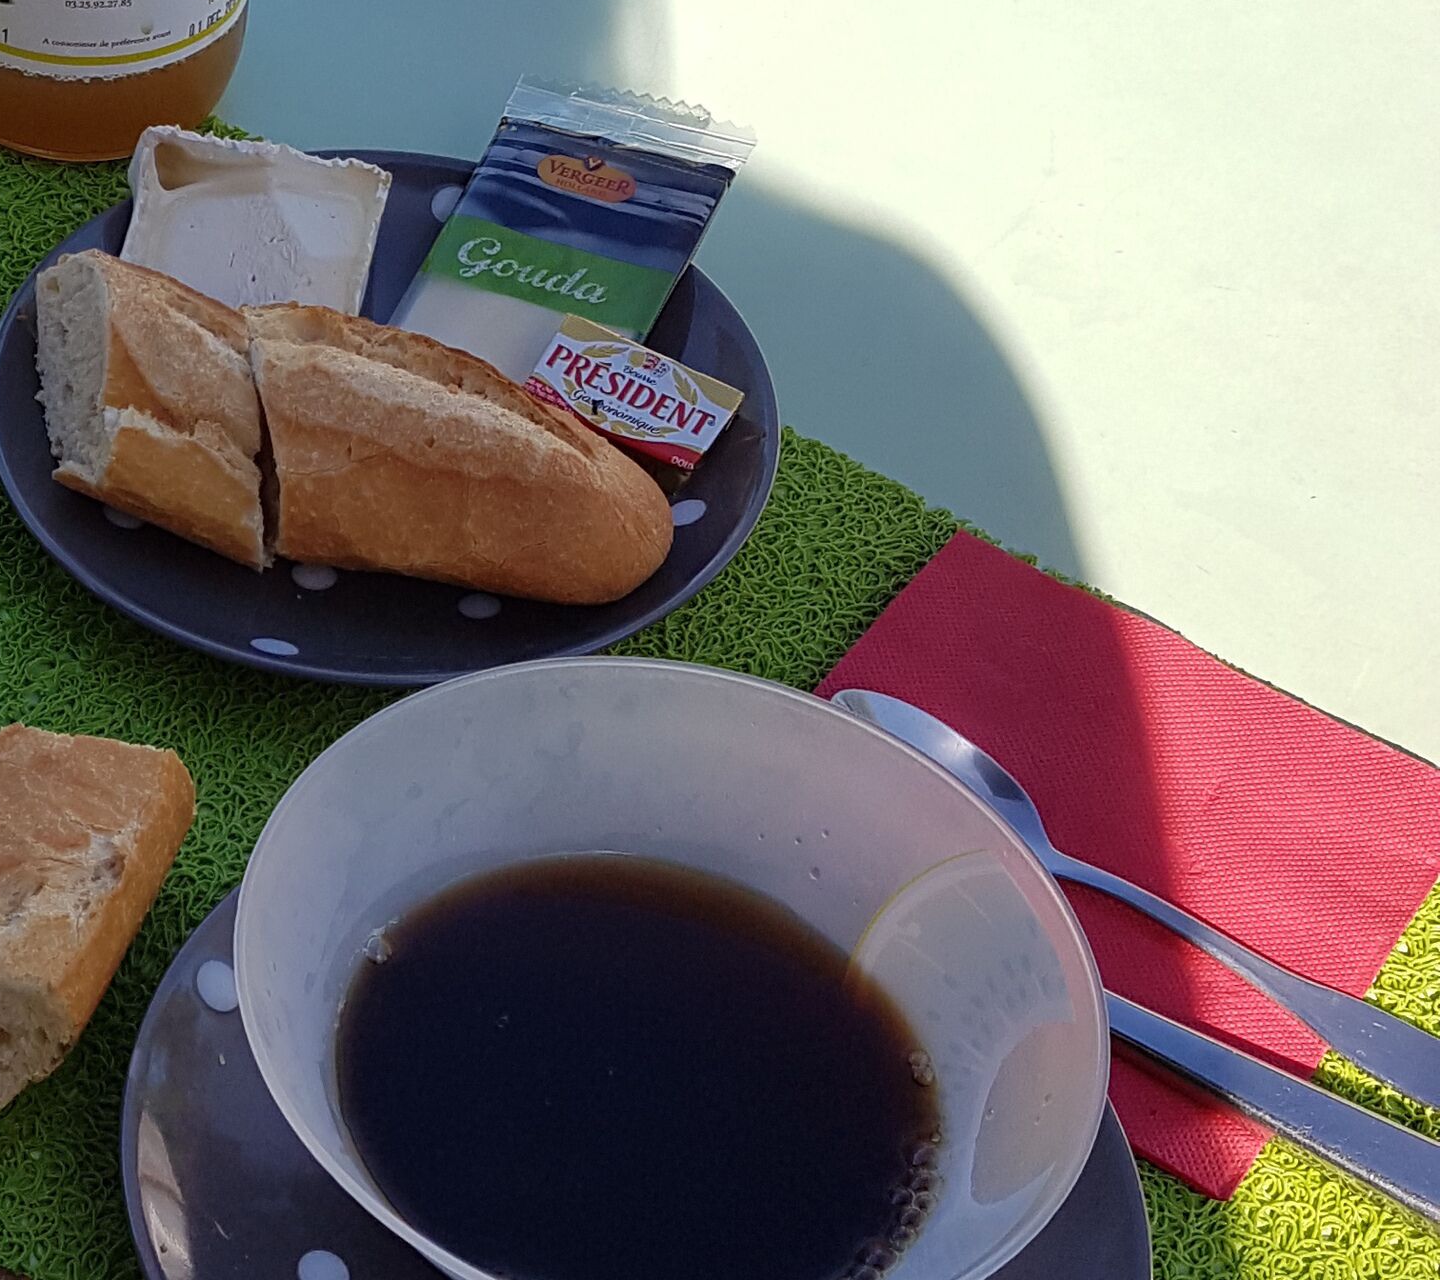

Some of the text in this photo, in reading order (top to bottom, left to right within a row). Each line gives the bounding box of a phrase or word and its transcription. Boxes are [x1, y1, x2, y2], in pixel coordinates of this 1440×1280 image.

[42, 37, 49, 45] A
[457, 237, 607, 304] Gouda
[546, 343, 715, 436] PRÉSIDENT
[623, 365, 658, 386] Beurre
[568, 389, 662, 435] Gaonomique
